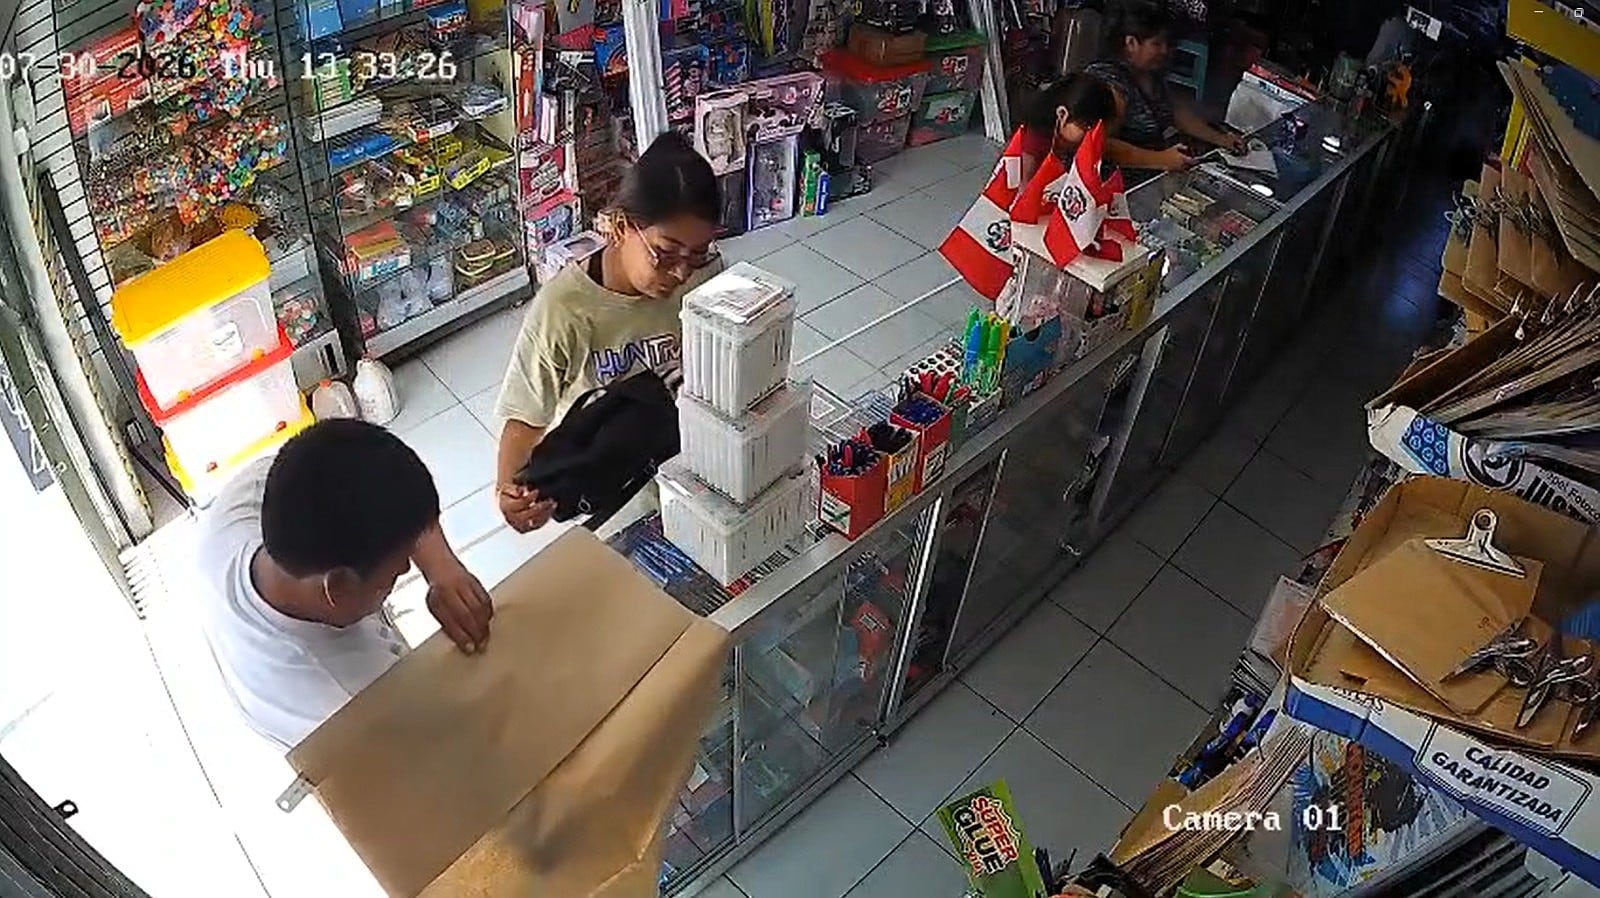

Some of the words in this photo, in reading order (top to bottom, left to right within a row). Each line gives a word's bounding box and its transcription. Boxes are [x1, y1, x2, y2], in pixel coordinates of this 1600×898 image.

[1538, 467, 1569, 493] apel
[1431, 751, 1563, 823] GARANTIZADA
[1465, 747, 1550, 790] CALIDAD
[953, 806, 1004, 873] GLUE
[972, 797, 1018, 860] SUPER
